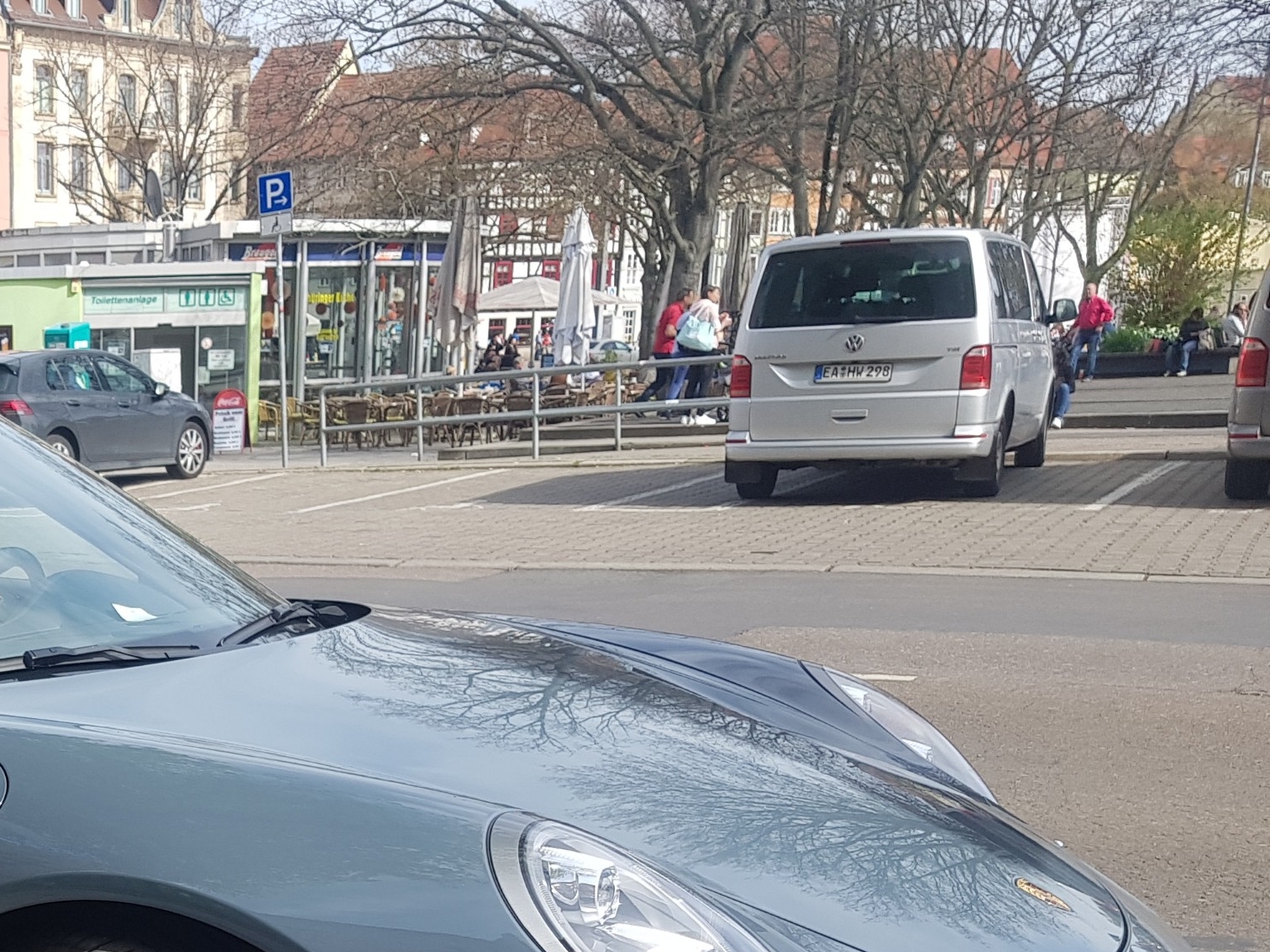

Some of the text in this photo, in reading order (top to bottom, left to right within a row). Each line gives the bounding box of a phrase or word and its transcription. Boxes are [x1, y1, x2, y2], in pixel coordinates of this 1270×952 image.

[266, 178, 284, 208] P
[91, 295, 157, 305] Toilettenanlage
[822, 365, 890, 378] EA HW 298
